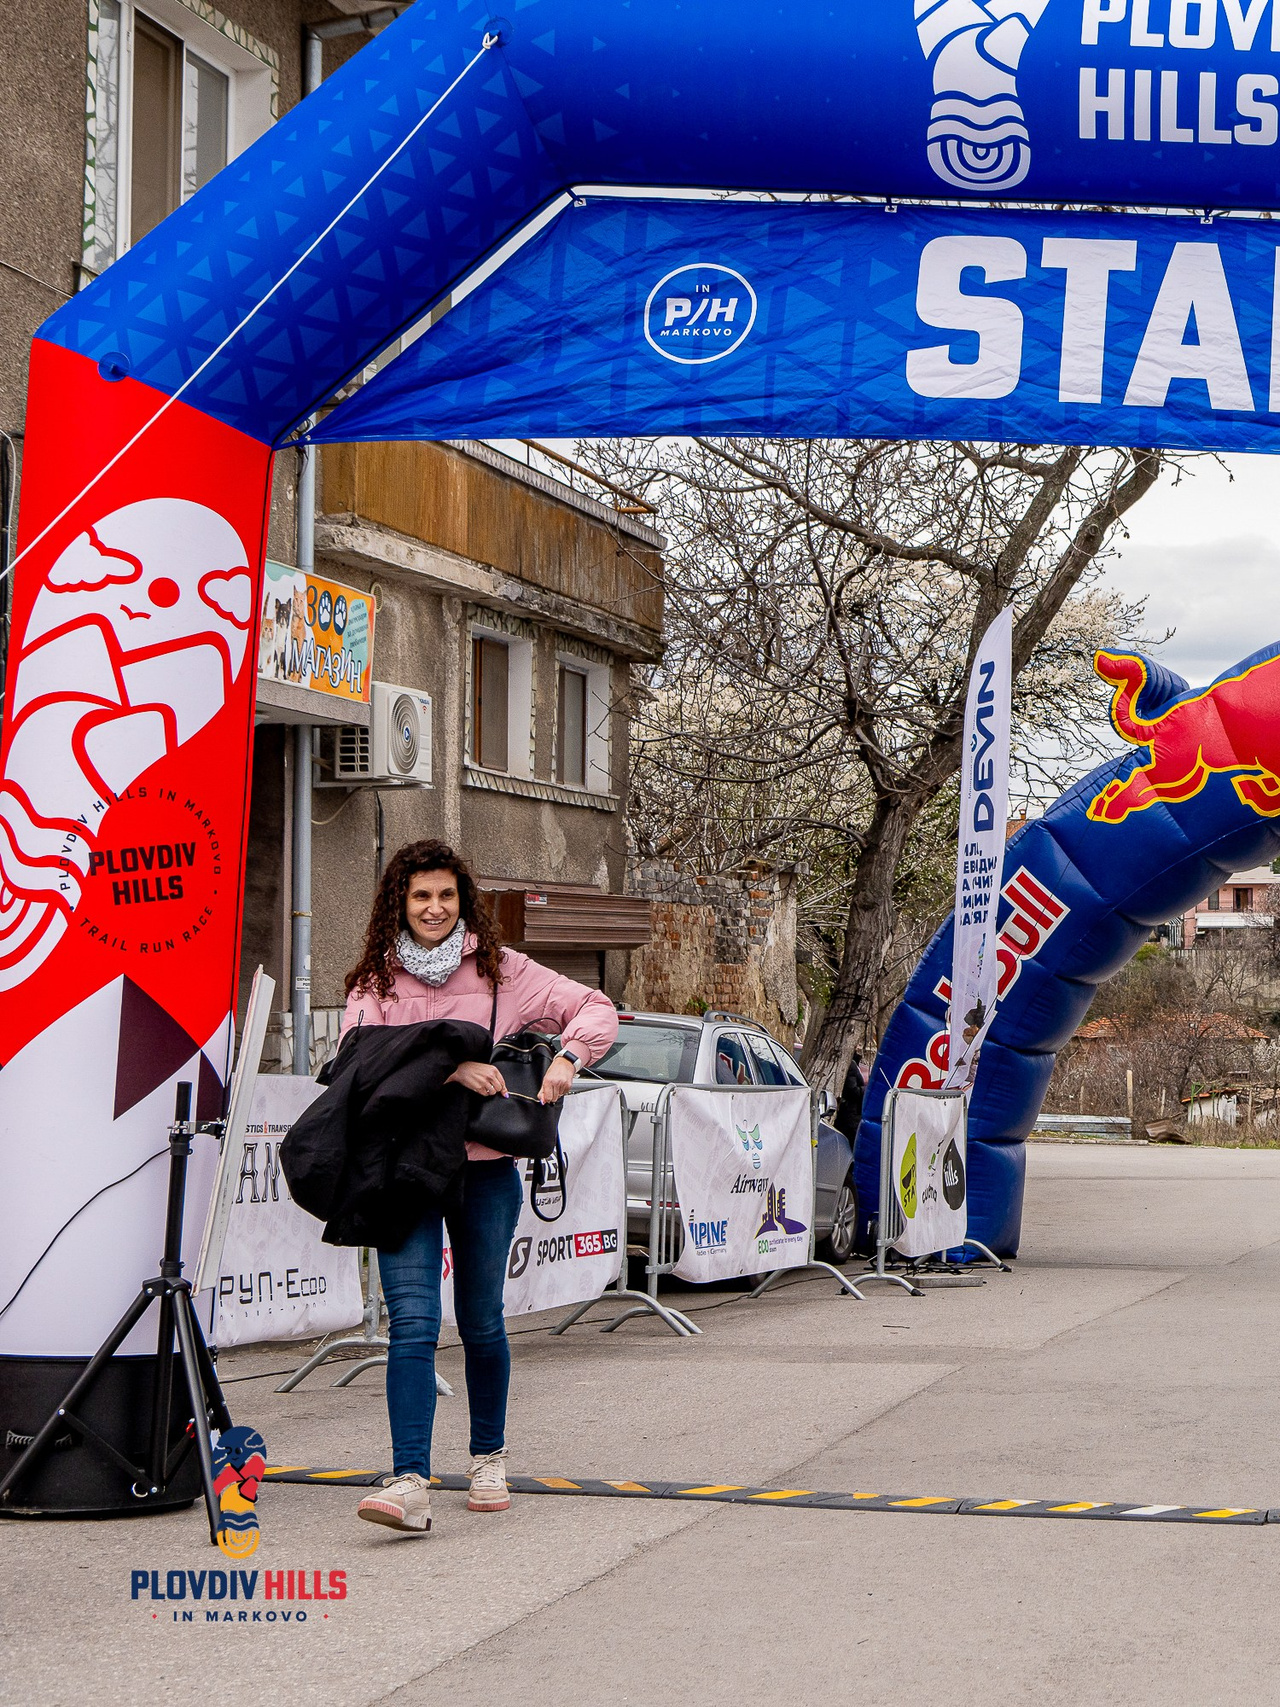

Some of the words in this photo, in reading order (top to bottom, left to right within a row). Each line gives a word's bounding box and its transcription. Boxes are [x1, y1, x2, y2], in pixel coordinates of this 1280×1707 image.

[1079, 67, 1279, 146] HILLS
[695, 284, 710, 293] IN
[664, 297, 738, 327] P/H
[660, 328, 732, 337] MARKOVO
[291, 637, 362, 694] МАГАЗИН
[59, 814, 89, 891] PLOVDIV
[93, 787, 147, 813] HILLS
[159, 788, 177, 802] IN
[184, 799, 222, 875] MARKOVO
[88, 842, 197, 877] PLOVDIV
[112, 875, 184, 906] HILLS
[79, 917, 128, 952] TRAIL
[139, 939, 175, 953] RUN
[182, 906, 212, 942] RACE
